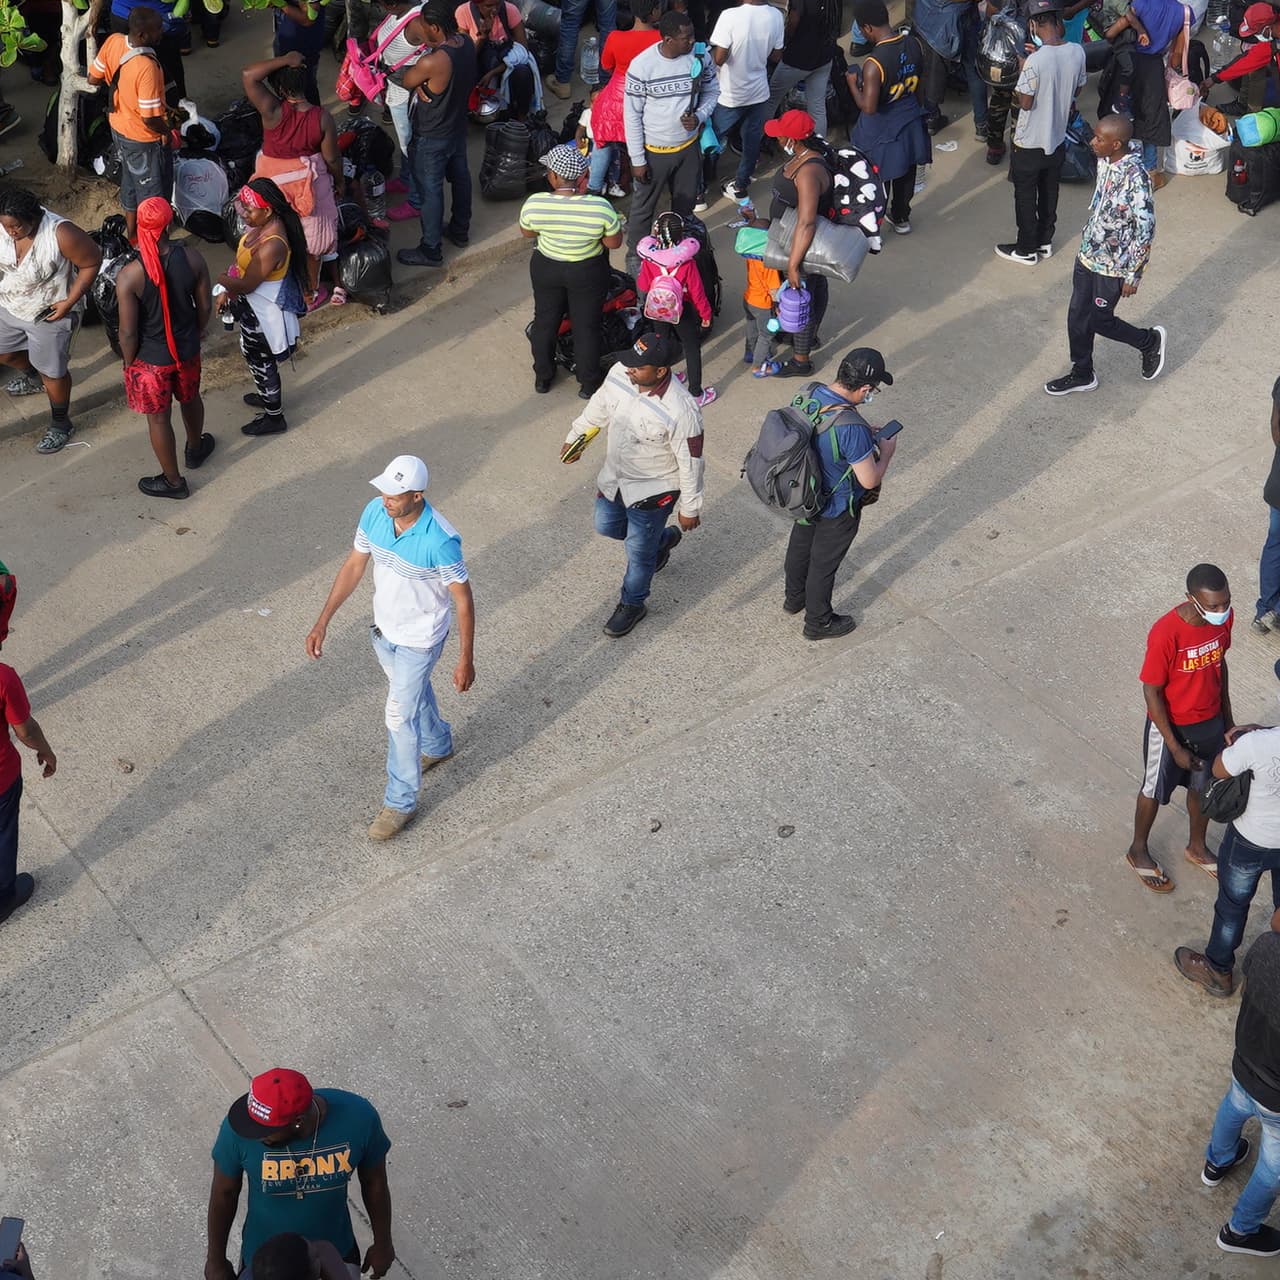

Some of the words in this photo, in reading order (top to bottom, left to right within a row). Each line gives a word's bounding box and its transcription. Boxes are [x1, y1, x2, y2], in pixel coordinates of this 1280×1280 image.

[647, 82, 680, 94] NEVER
[1183, 658, 1199, 670] LAS
[1201, 652, 1211, 666] DE
[261, 1148, 352, 1181] BRONX
